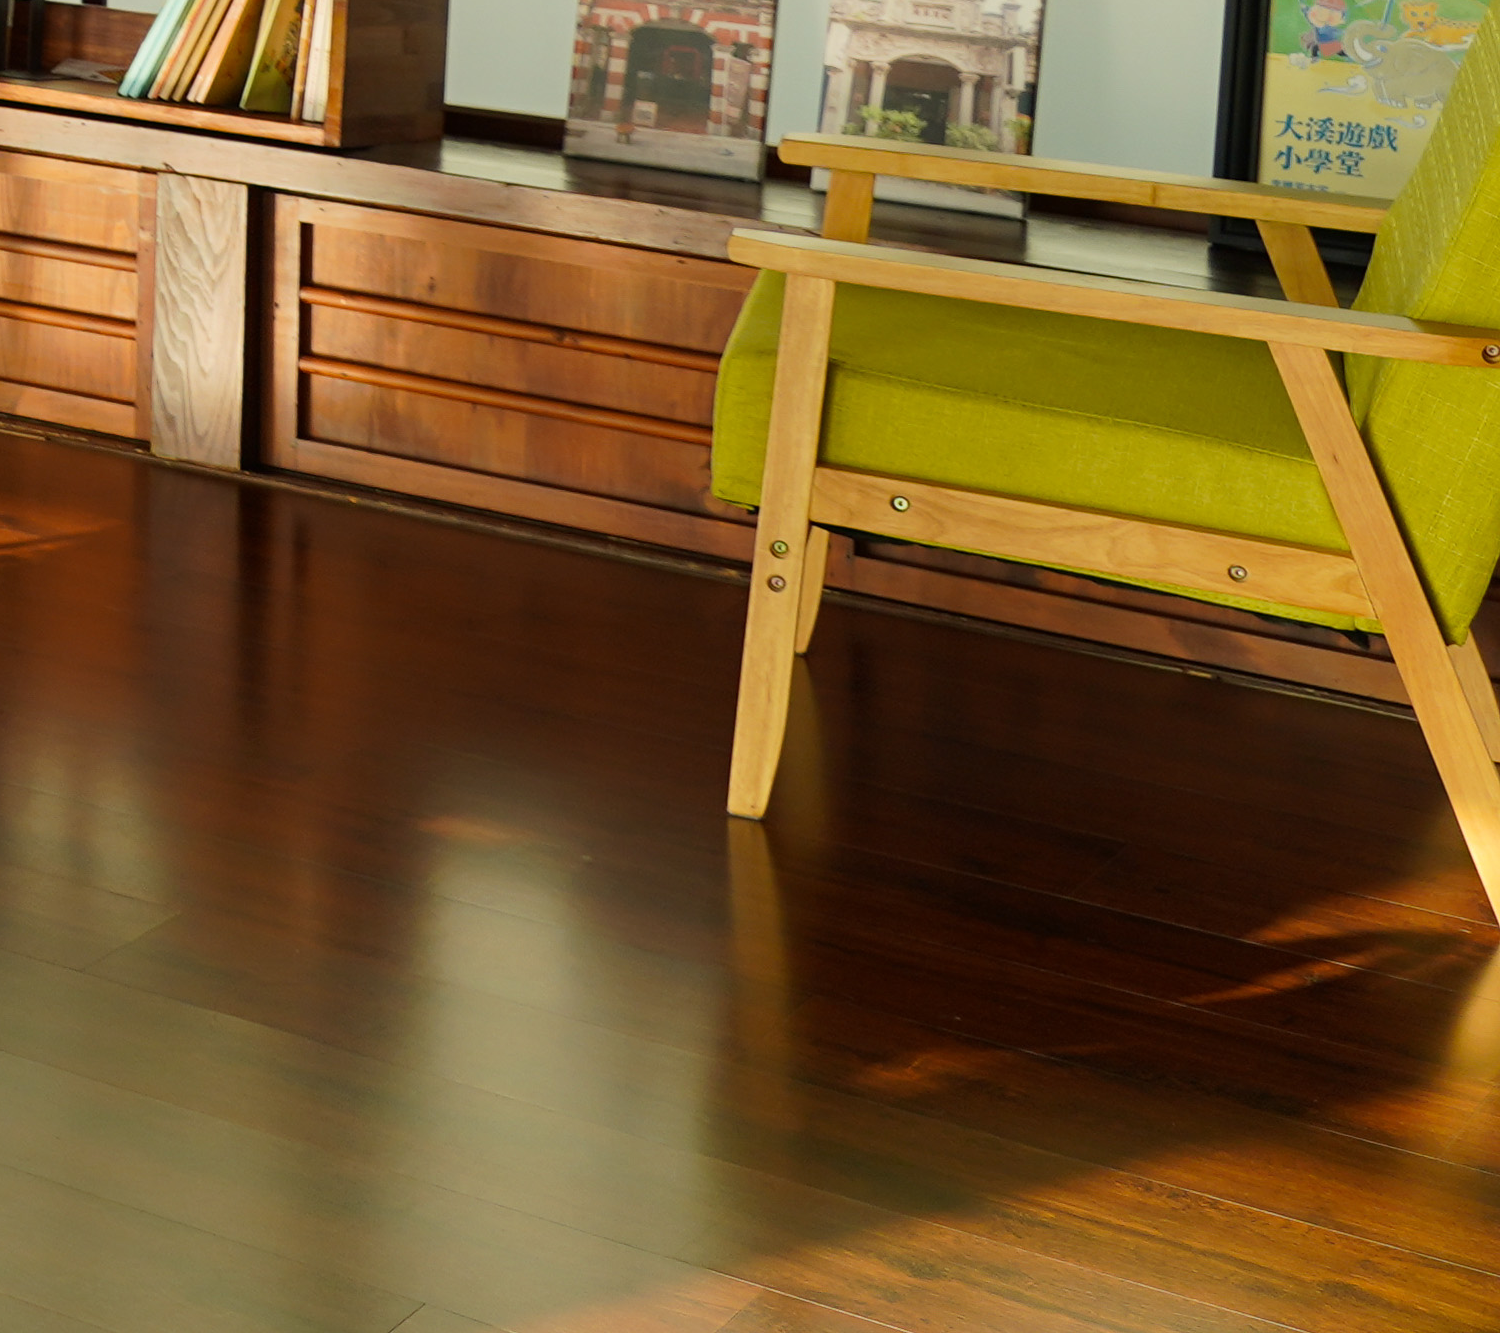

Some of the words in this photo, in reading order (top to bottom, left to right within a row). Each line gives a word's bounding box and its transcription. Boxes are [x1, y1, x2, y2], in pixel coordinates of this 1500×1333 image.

[1274, 113, 1399, 152] 大溪遊戲
[1274, 145, 1366, 178] 小學堂
